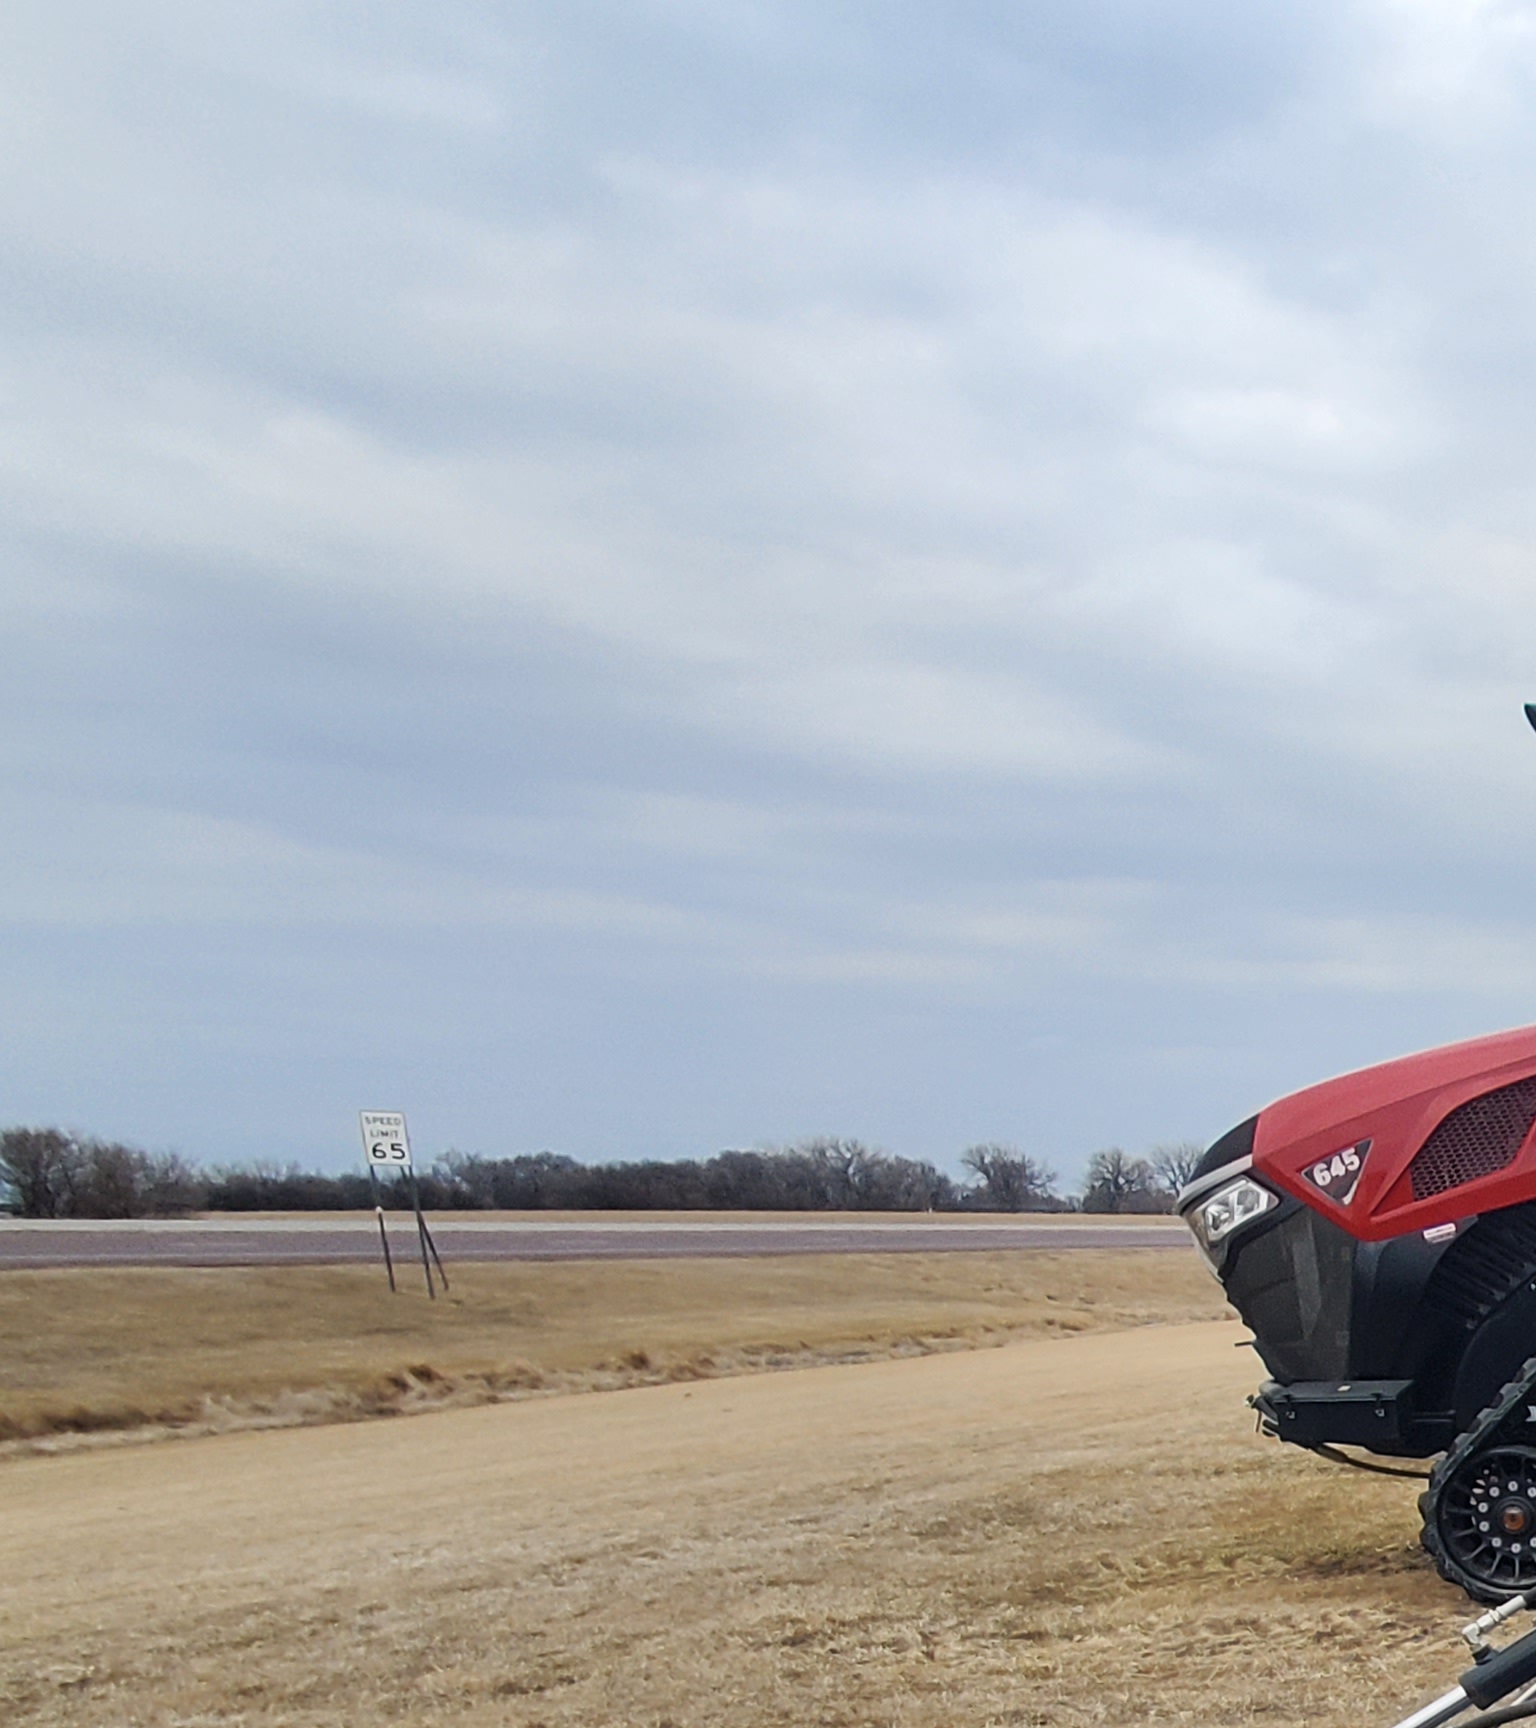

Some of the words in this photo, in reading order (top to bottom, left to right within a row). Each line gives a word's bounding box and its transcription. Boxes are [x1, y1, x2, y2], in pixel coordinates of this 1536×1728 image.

[365, 1116, 401, 1126] SPEED
[370, 1129, 398, 1139] LIMIT
[372, 1142, 406, 1160] 65
[1313, 1147, 1360, 1187] 645
